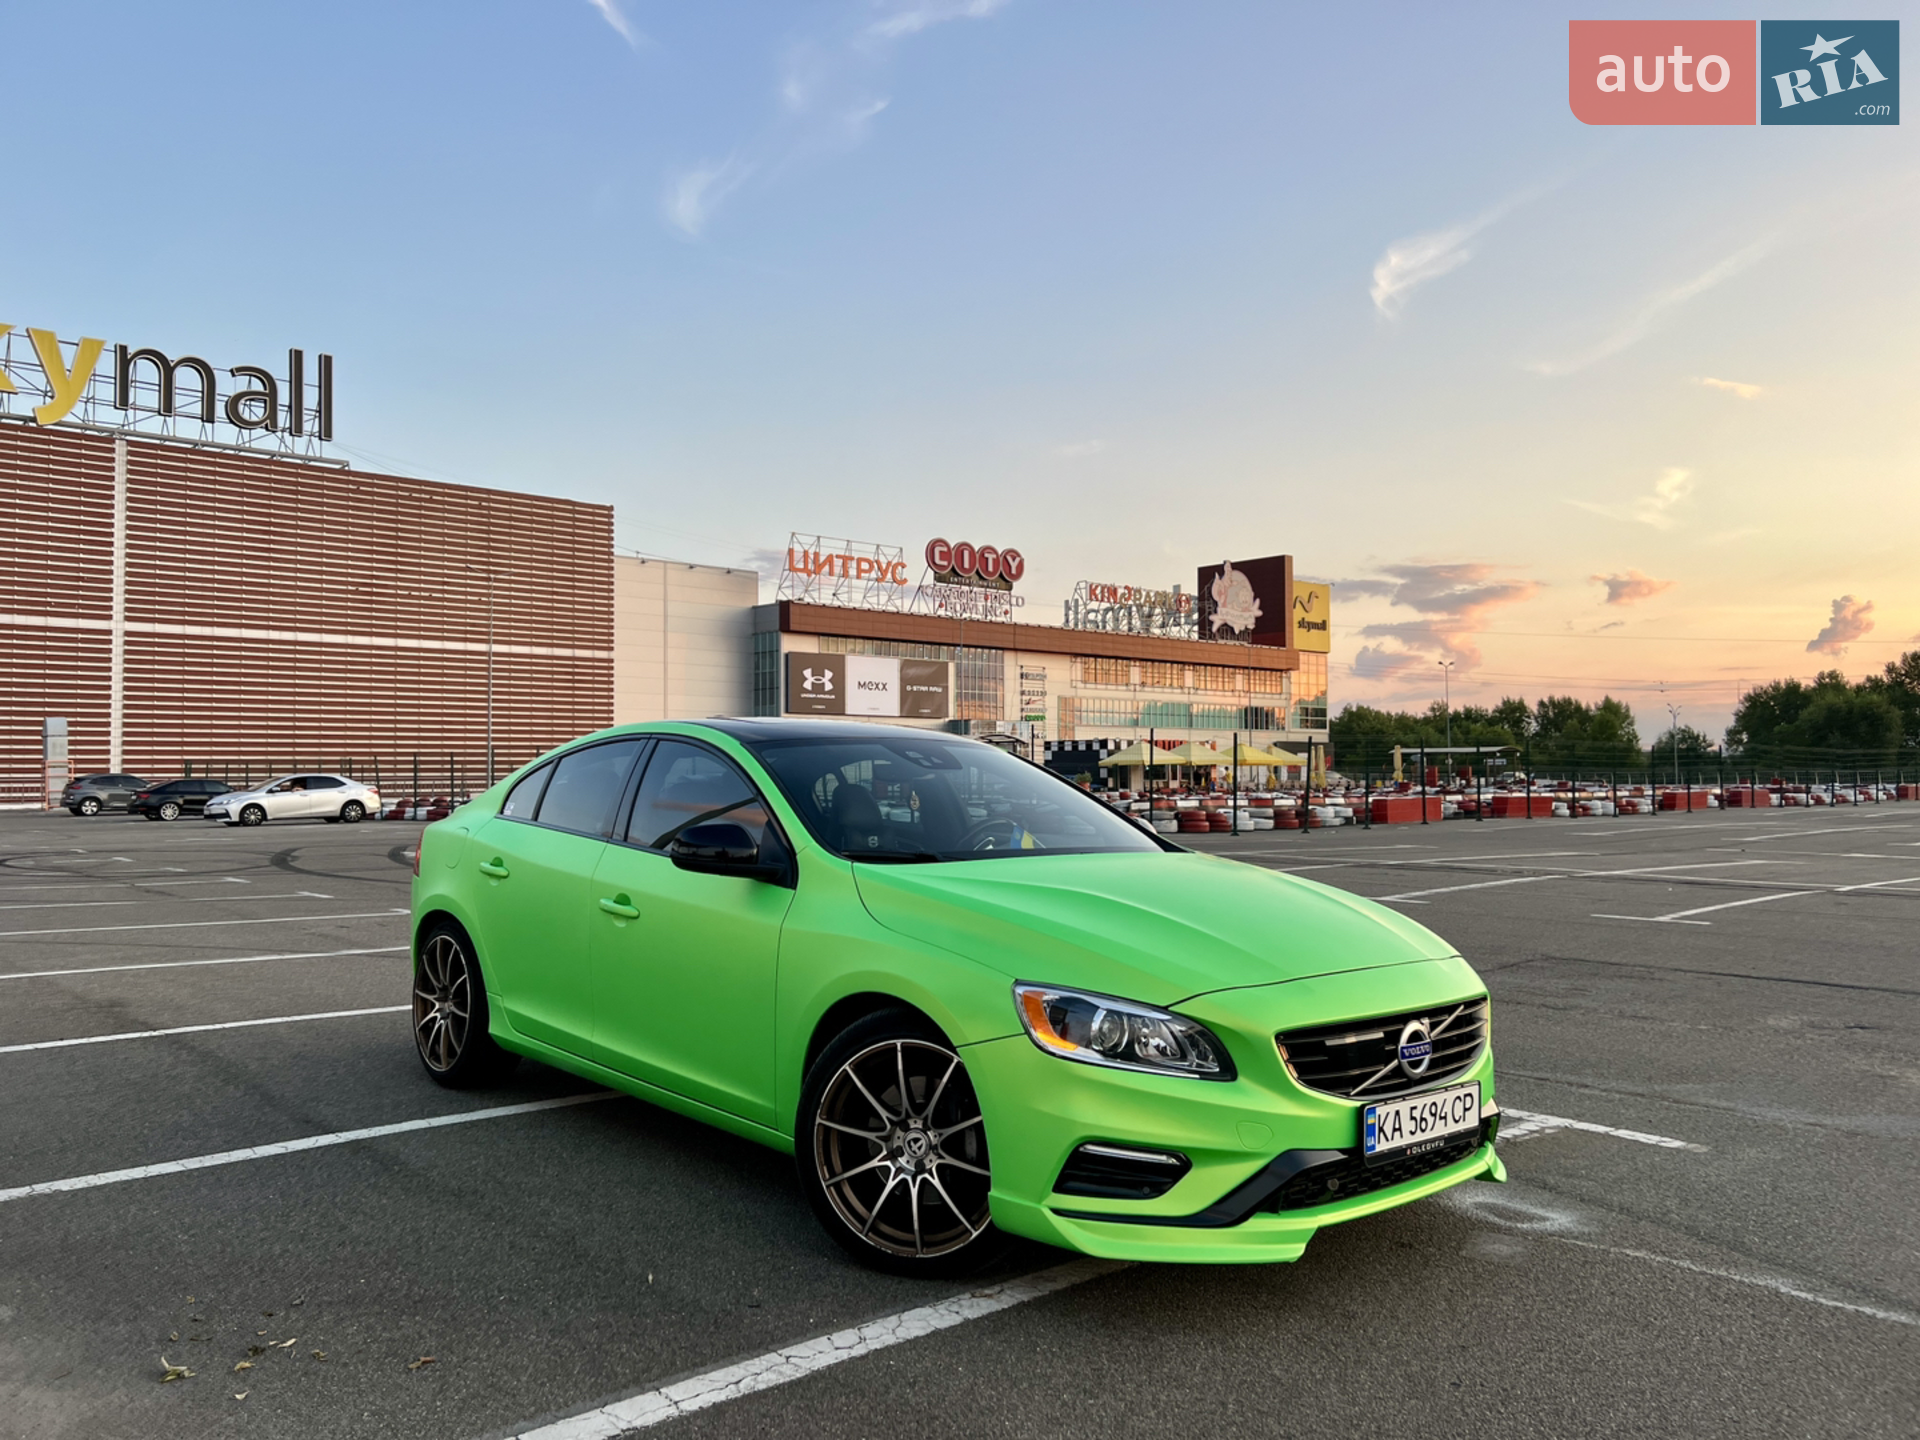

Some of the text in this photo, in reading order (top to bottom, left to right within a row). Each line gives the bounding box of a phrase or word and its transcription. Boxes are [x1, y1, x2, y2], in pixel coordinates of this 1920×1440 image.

[788, 547, 909, 586] ЦИТРУС
[931, 544, 1021, 576] CITY
[1402, 1044, 1431, 1057] VOLVO
[1377, 1092, 1474, 1145] KA 5694 CP
